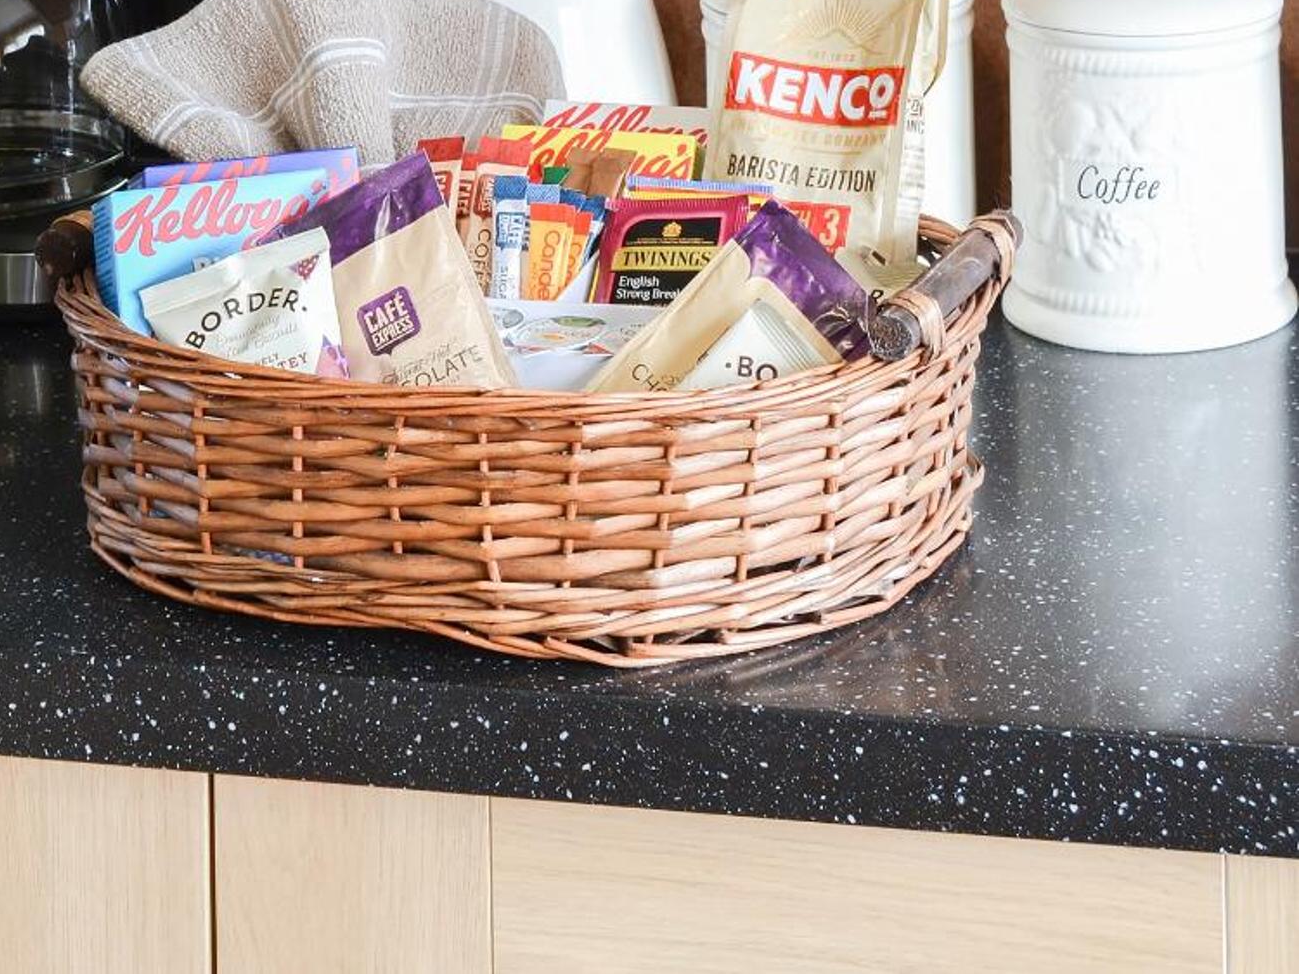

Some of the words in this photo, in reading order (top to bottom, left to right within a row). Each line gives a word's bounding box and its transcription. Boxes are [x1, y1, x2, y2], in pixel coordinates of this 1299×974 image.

[734, 57, 895, 121] KENCO
[725, 153, 801, 186] BARISTA
[804, 165, 877, 194] EDITION
[1076, 164, 1162, 205] Coffee
[818, 208, 841, 247] 3
[623, 250, 711, 267] TWININGS
[615, 288, 651, 302] Strong
[618, 275, 660, 289] English
[371, 316, 415, 349] EXPRESS
